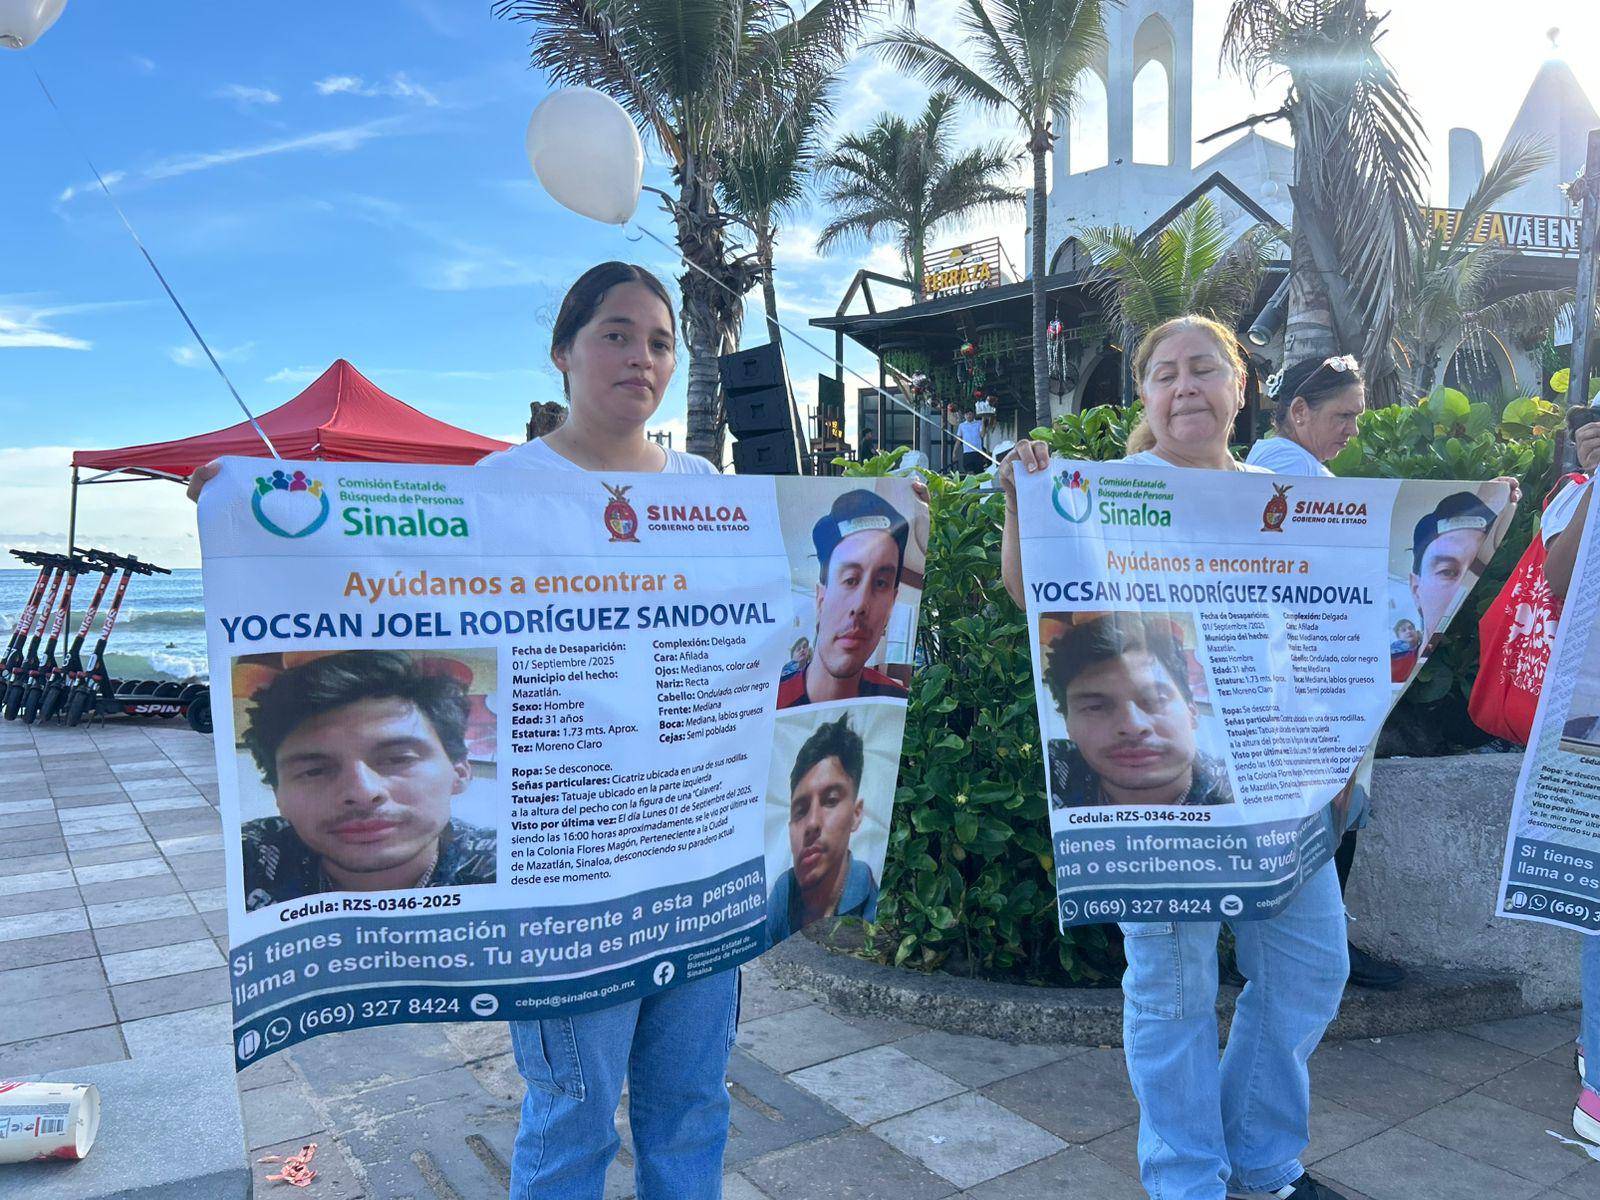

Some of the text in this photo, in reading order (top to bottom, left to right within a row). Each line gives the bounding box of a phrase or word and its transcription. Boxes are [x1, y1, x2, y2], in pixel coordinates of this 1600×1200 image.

[1502, 214, 1581, 247] VALEN
[925, 262, 991, 292] TERRAZA
[338, 477, 446, 492] Comisión Estatal de
[1099, 477, 1166, 489] Comisión Estatal de
[339, 490, 464, 505] Búsqueda de Personas
[1098, 488, 1174, 501] Búsqueda de Personas
[647, 505, 747, 522] SINALOA
[1099, 502, 1171, 527] Sinaloa
[1294, 501, 1367, 516] SINALOA
[343, 507, 469, 537] Sinaloa
[1107, 551, 1308, 575] Ayúdanos a encontrar a
[343, 570, 687, 603] Ayúdanos a encontrar a
[1031, 580, 1373, 604] YOCSAN JOEL RODRÍGUEZ SANDOVAL
[51, 608, 66, 637] SPIN
[79, 607, 96, 636] SPIN
[102, 608, 117, 639] SPIN
[220, 602, 775, 643] YOCSAN JOEL RODRÍGUEZ SANDOVAL
[512, 641, 626, 656] Fecha de Desaparición:
[652, 635, 746, 650] Complexión: Delgada
[512, 656, 614, 671] 01/ Septiembre /2025
[654, 650, 709, 662] Cara: Afilada
[655, 659, 760, 677] Ojos: Medianos, color café
[513, 670, 618, 685] Municipio del hecho:
[656, 678, 709, 689] Nariz: Recta
[512, 687, 561, 698] Mazatlán.
[657, 691, 695, 702] Cabello:
[733, 684, 750, 694] color
[751, 682, 769, 692] negro
[136, 704, 181, 713] SPIN
[512, 700, 584, 712] Sexo: Hombre
[658, 702, 722, 716] Frente: Mediana
[512, 714, 583, 725] Edad: 31 años
[659, 707, 763, 729] Boca: Mediana, labios gruesos
[512, 725, 638, 739] Estatura: 1.73 mts. Aprox.
[659, 723, 736, 744] Cejas: Semi pobladas
[511, 740, 602, 753] Tez: Moreno Claro
[512, 764, 613, 778] Ropa: Se desconoce.
[1541, 765, 1563, 774] Ropa:
[512, 776, 610, 791] Señas particulares:
[511, 790, 596, 805] Tatuajes: Tatuaje
[1534, 791, 1576, 805] tipo código.
[511, 817, 617, 831] Visto por última vez:
[1069, 811, 1211, 824] Cedula: RZS-0346-2025
[1059, 839, 1116, 855] tienes
[1126, 834, 1247, 851] información
[1087, 862, 1099, 873] o
[1105, 857, 1222, 873] escribenos.
[1228, 855, 1252, 870] Tu
[1259, 850, 1295, 873] ayuda
[1521, 845, 1593, 869] Si tienes
[511, 871, 611, 885] desde ese momento.
[1518, 861, 1599, 889] llama o es
[280, 894, 461, 922] Cedula: RZS-0346-2025
[1084, 898, 1211, 919] (669) 327 8424
[1550, 899, 1589, 921] (669)
[233, 871, 765, 977] Si tienes información referente a esta persona,
[235, 890, 765, 1006] llama o escribenos. Tu ayuda es muy importante.
[300, 980, 635, 1034] (669) 327 8424 cebpd@sinaloa.gob.mx
